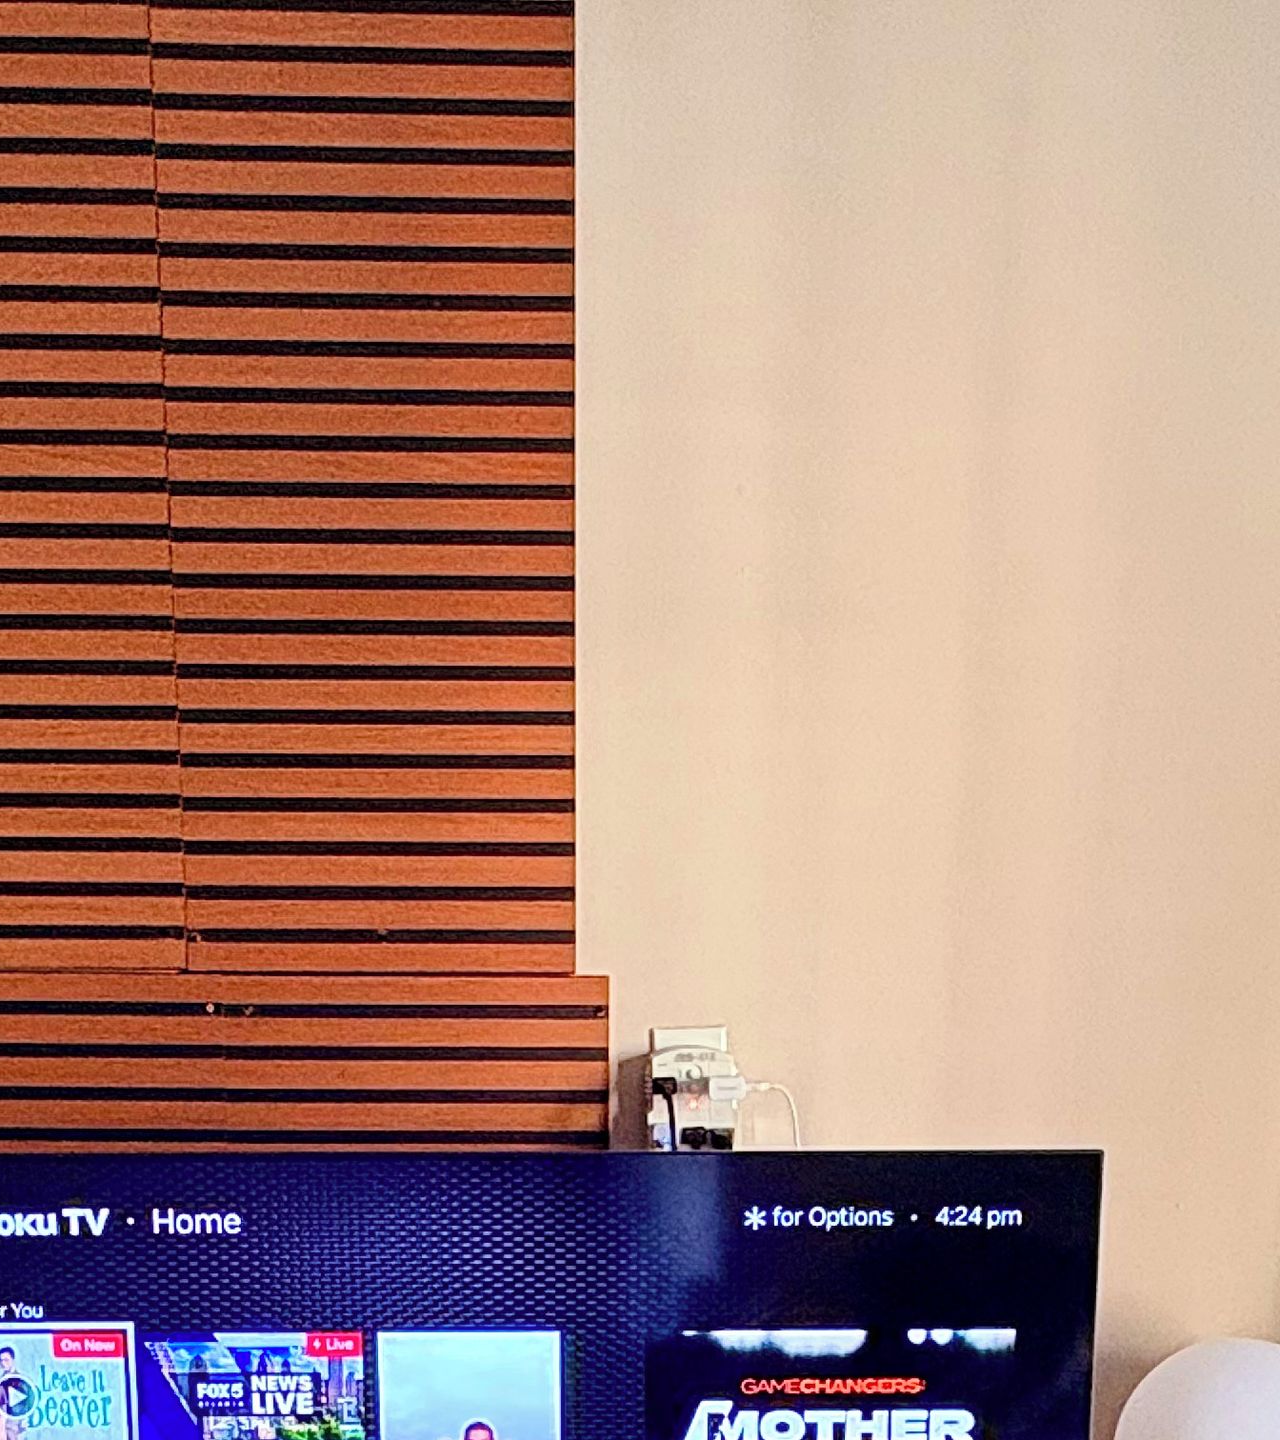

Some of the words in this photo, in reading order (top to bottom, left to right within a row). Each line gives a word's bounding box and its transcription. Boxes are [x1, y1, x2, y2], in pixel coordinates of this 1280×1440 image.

[61, 1207, 109, 1237] TV
[151, 1207, 242, 1235] Home
[771, 1205, 804, 1226] for
[808, 1205, 894, 1232] Options
[934, 1205, 983, 1227] 4:24
[986, 1208, 1023, 1230] pm
[10, 1302, 44, 1319] You
[60, 1338, 83, 1352] On
[84, 1338, 116, 1352] Now
[326, 1338, 354, 1352] Live
[40, 1364, 86, 1393] Leave
[250, 1374, 314, 1391] NEWS
[251, 1392, 314, 1415] LIVE
